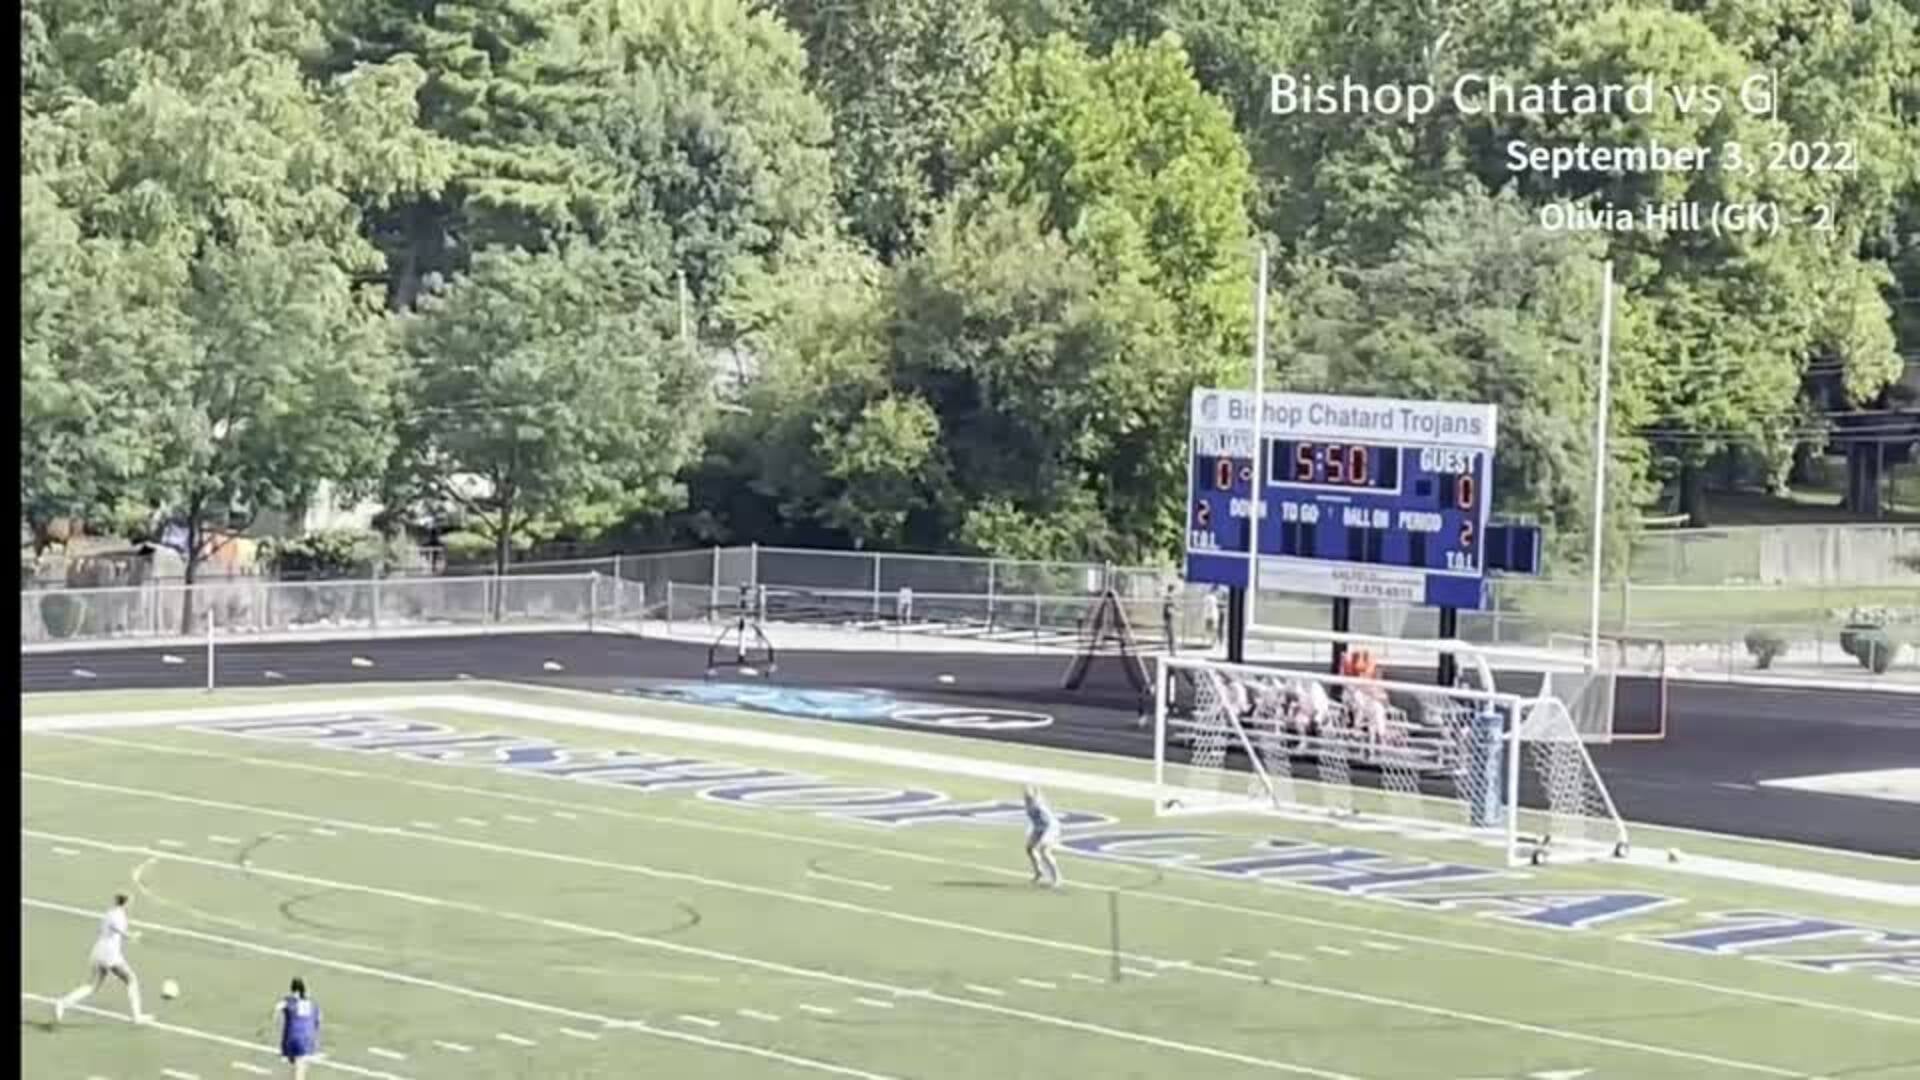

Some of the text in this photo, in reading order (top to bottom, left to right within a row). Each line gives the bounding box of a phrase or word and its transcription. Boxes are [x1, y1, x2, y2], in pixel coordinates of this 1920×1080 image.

[1308, 403, 1394, 431] Chatard
[1400, 408, 1482, 437] Trojans
[1216, 460, 1233, 490] 0
[1420, 448, 1475, 474] GUEST
[1458, 475, 1474, 509] 0
[1282, 501, 1320, 523] TO GO
